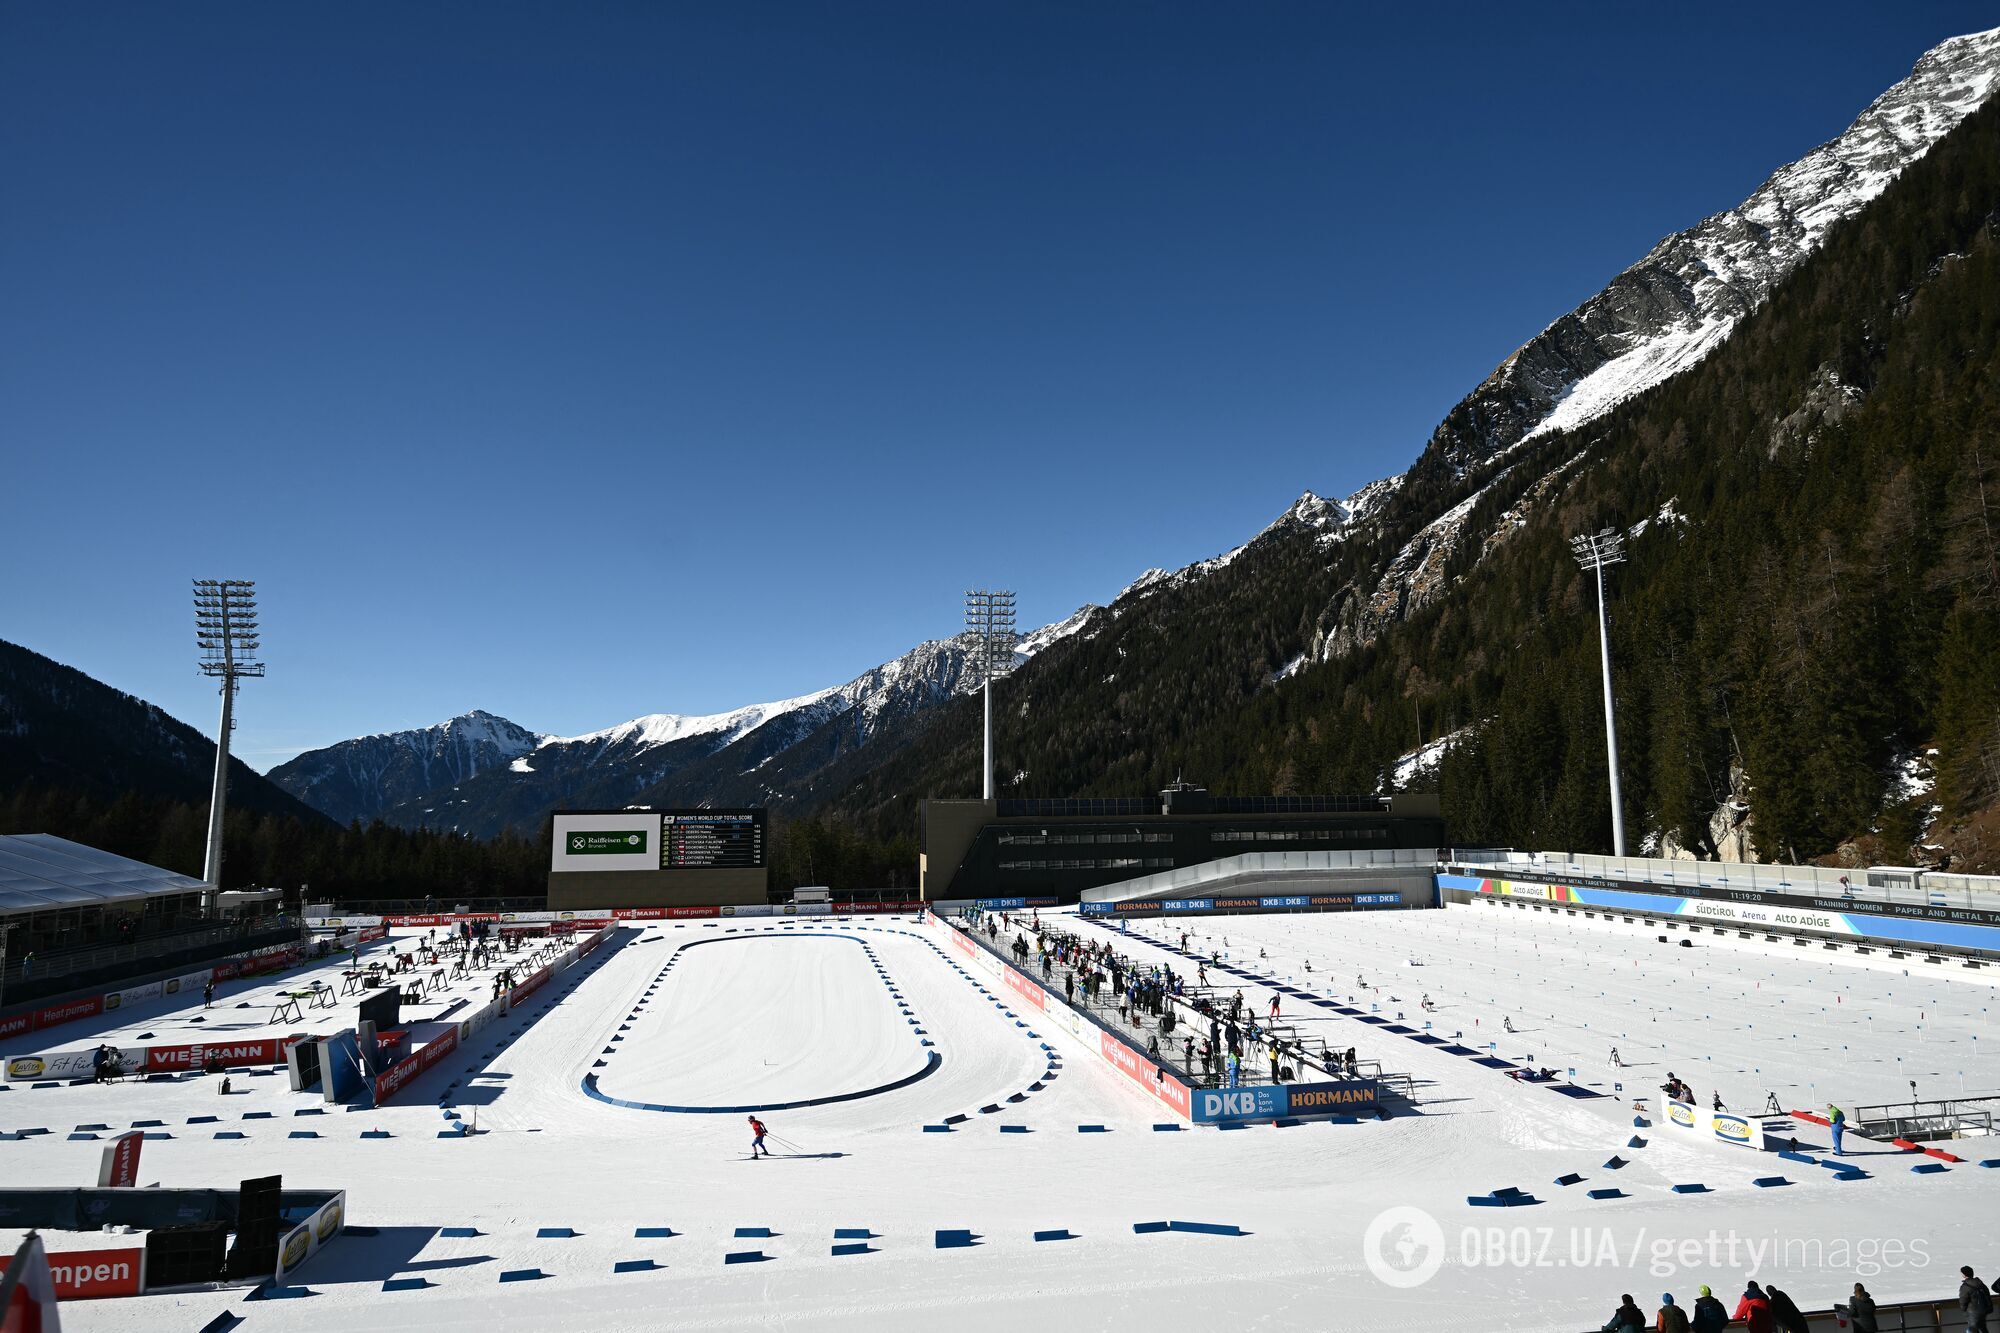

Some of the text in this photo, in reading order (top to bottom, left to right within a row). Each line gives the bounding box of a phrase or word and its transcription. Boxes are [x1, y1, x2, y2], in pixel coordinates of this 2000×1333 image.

[1731, 892, 1761, 900] 11:19:20
[617, 909, 661, 919] VIESSMANN
[837, 903, 878, 912] VIESSMANN
[1742, 911, 1766, 920] Arena
[1814, 900, 1849, 909] TRAINING
[1853, 903, 1883, 911] WOMEN
[1895, 907, 1923, 916] PAPER
[1951, 911, 1983, 921] METAL
[389, 916, 435, 926] VIESSMANN
[44, 1002, 94, 1022] Heat pumps
[1104, 1039, 1136, 1071] VIESSMANN
[51, 1057, 70, 1070] Fit
[71, 1056, 95, 1073] für
[381, 1059, 417, 1092] VIESSMANN
[1205, 1092, 1256, 1116] DKB
[1291, 1089, 1374, 1107] HÖRMANN
